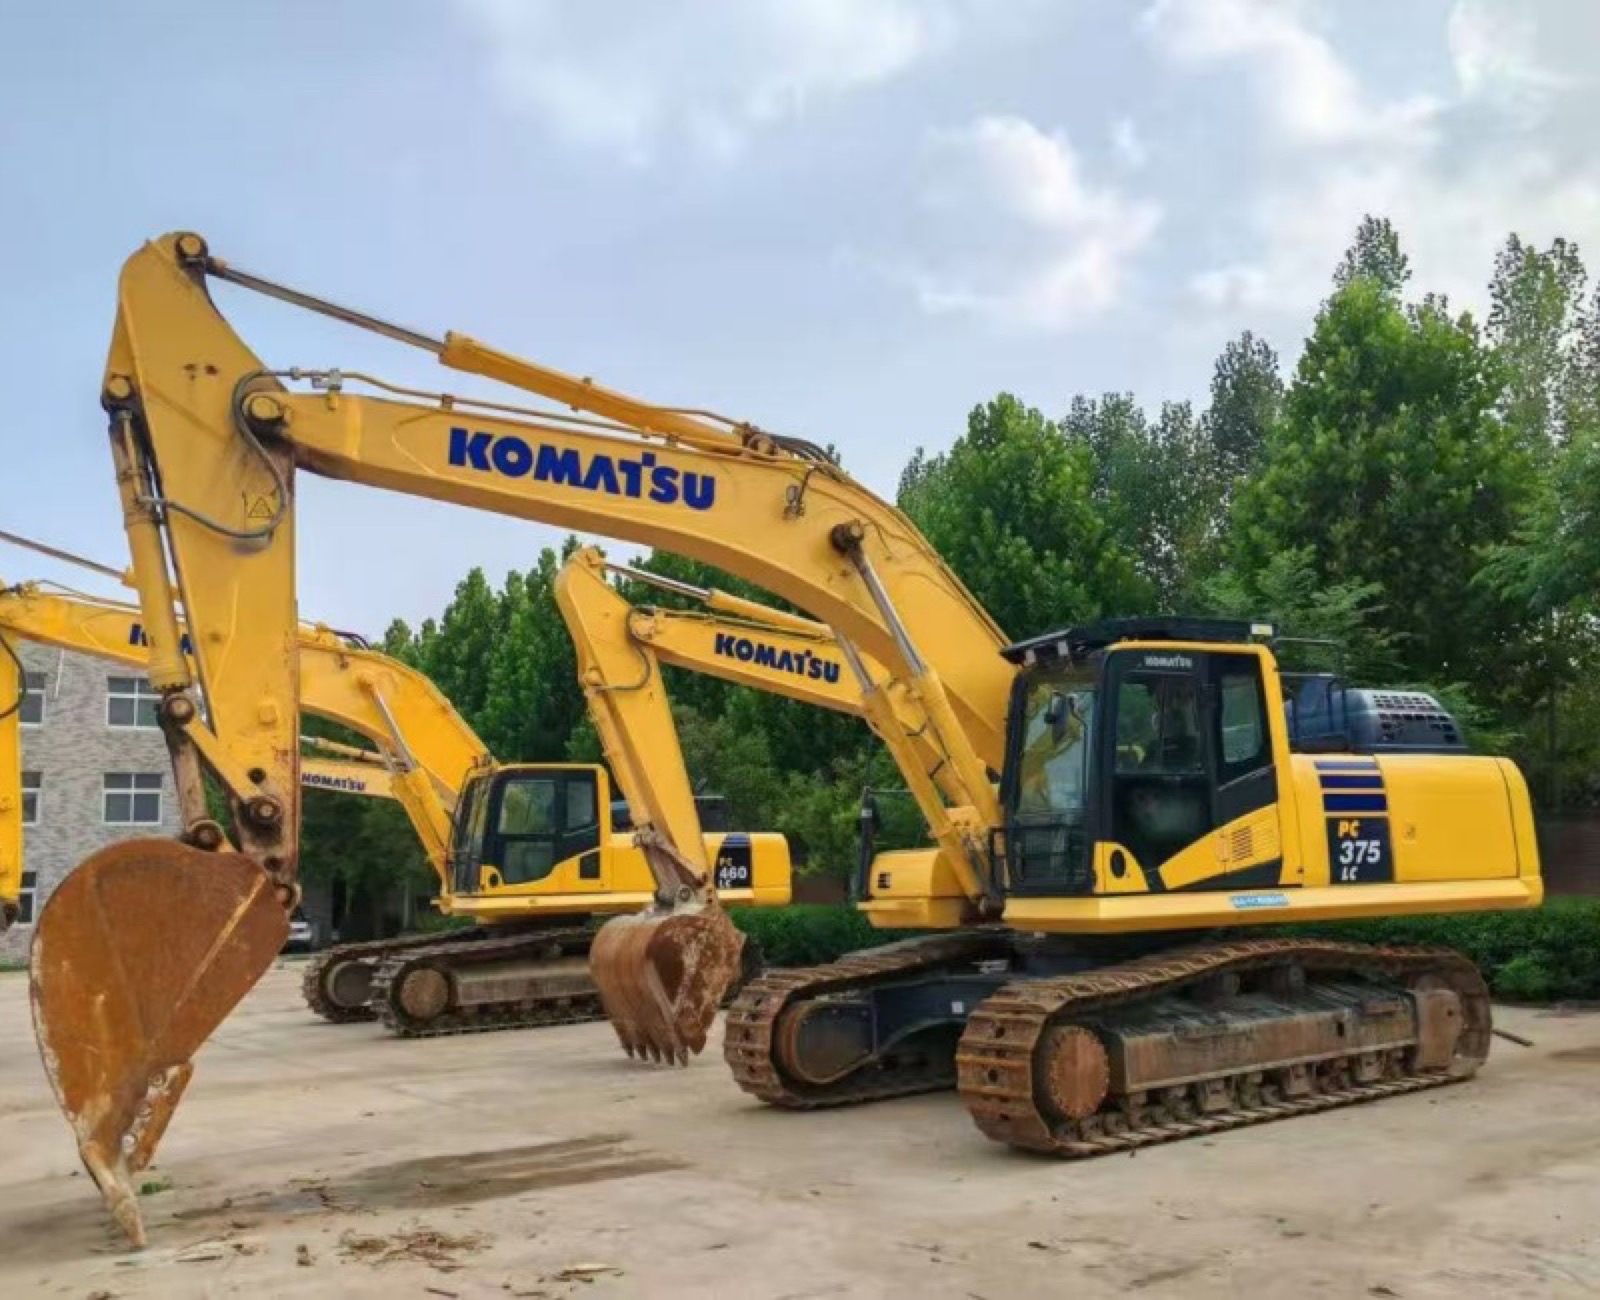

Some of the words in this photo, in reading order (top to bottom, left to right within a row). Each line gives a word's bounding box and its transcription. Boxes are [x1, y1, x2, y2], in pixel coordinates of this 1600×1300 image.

[448, 426, 716, 511] KOMATSU
[715, 631, 840, 684] KOMATSU
[301, 773, 366, 791] KOMATSU
[1338, 819, 1360, 838] PC
[1339, 840, 1381, 864] 375
[719, 865, 748, 879] 460
[1341, 865, 1359, 881] LC
